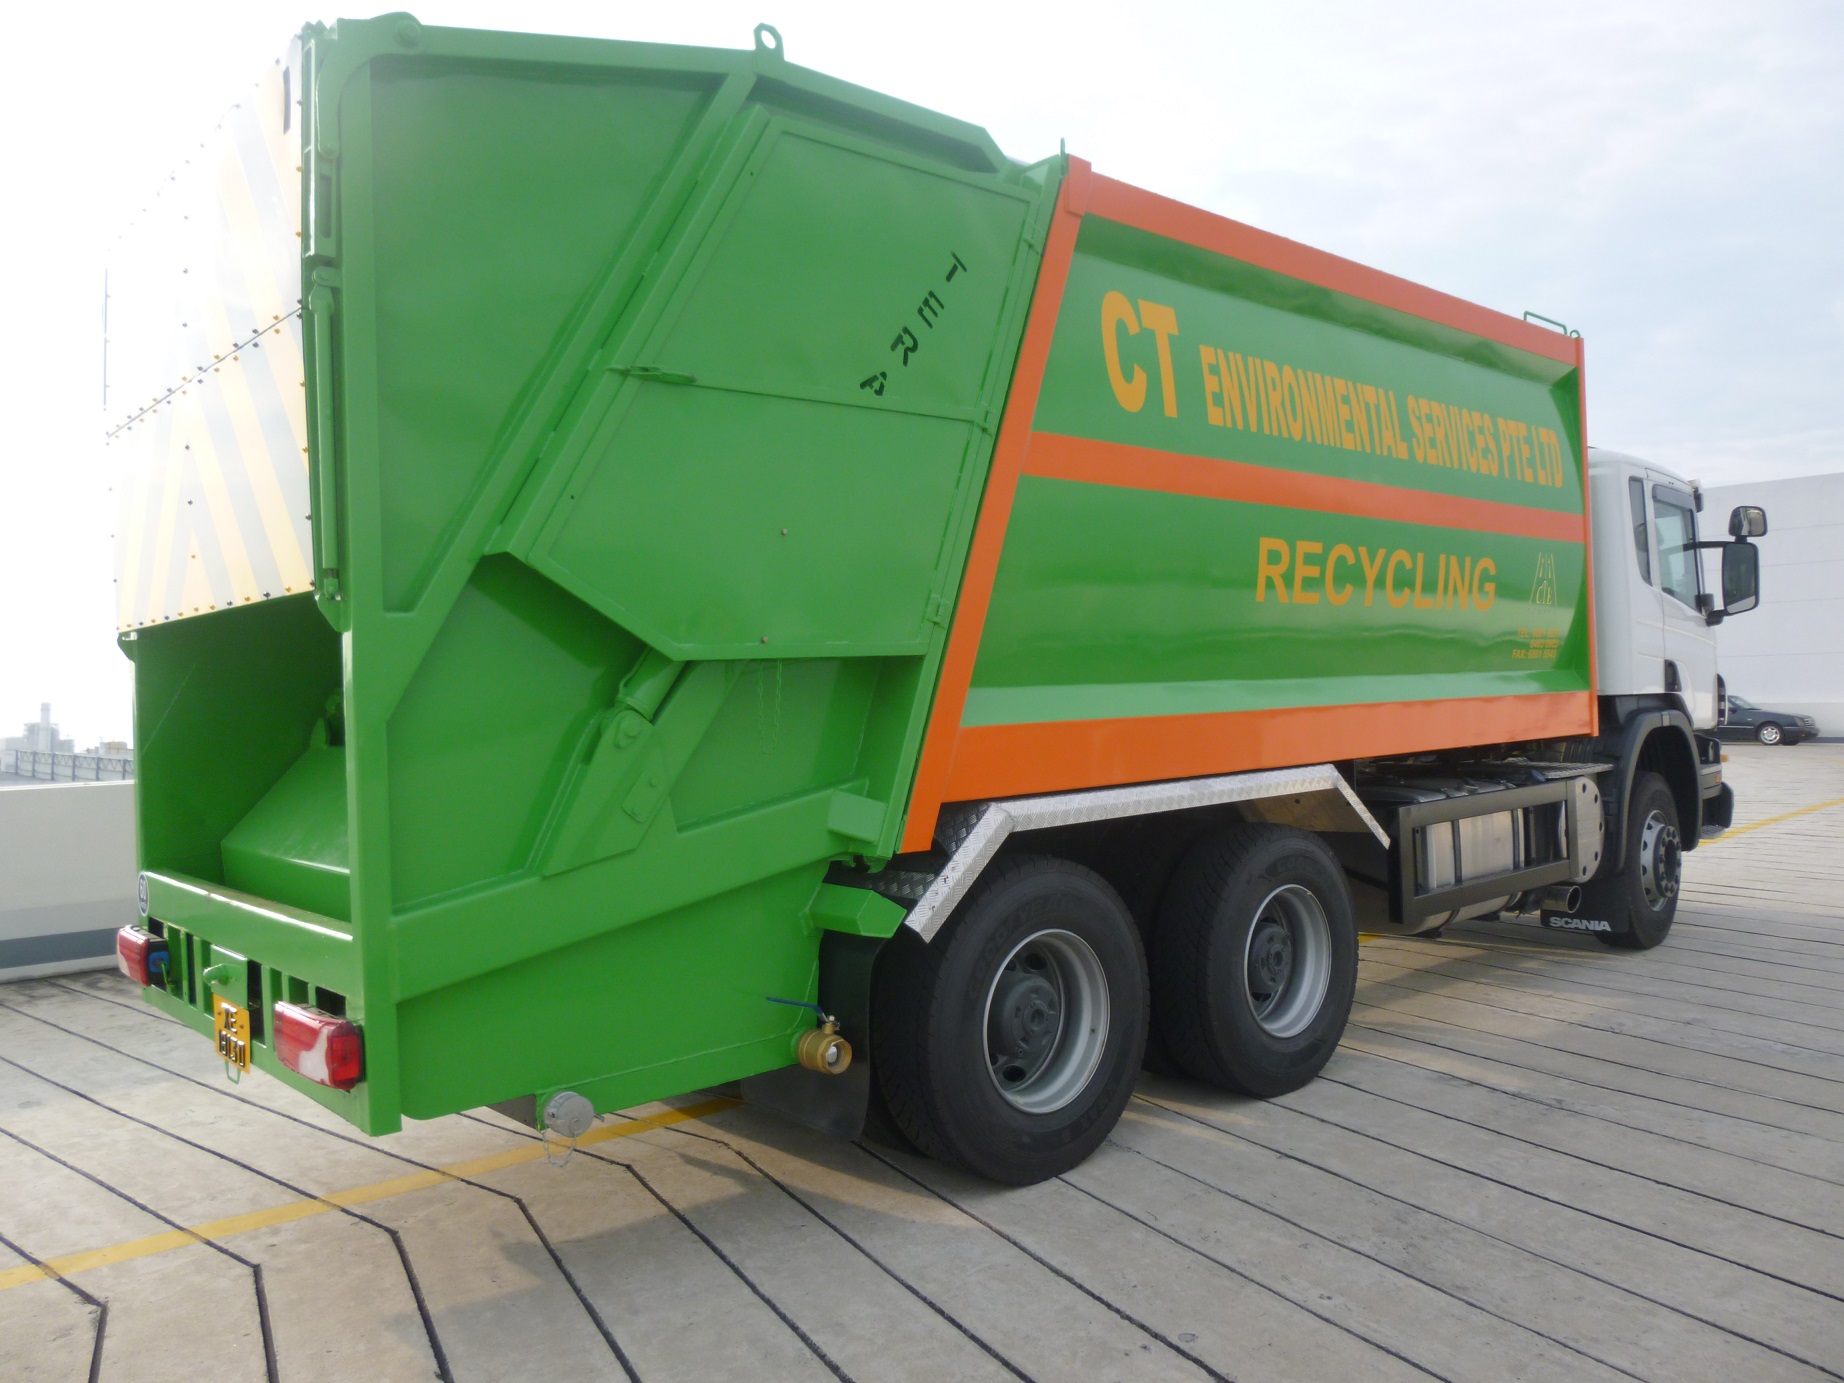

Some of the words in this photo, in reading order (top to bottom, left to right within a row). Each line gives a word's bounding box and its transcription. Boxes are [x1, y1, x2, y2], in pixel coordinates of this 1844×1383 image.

[1101, 290, 1179, 418] CT
[1199, 344, 1409, 460] ENVIRONMENTAL
[1407, 395, 1499, 477] SERVICES
[1497, 417, 1534, 483] PTE
[1533, 426, 1564, 488] LTD
[1256, 536, 1497, 612] RECYCLING
[1549, 916, 1612, 932] SCANIA
